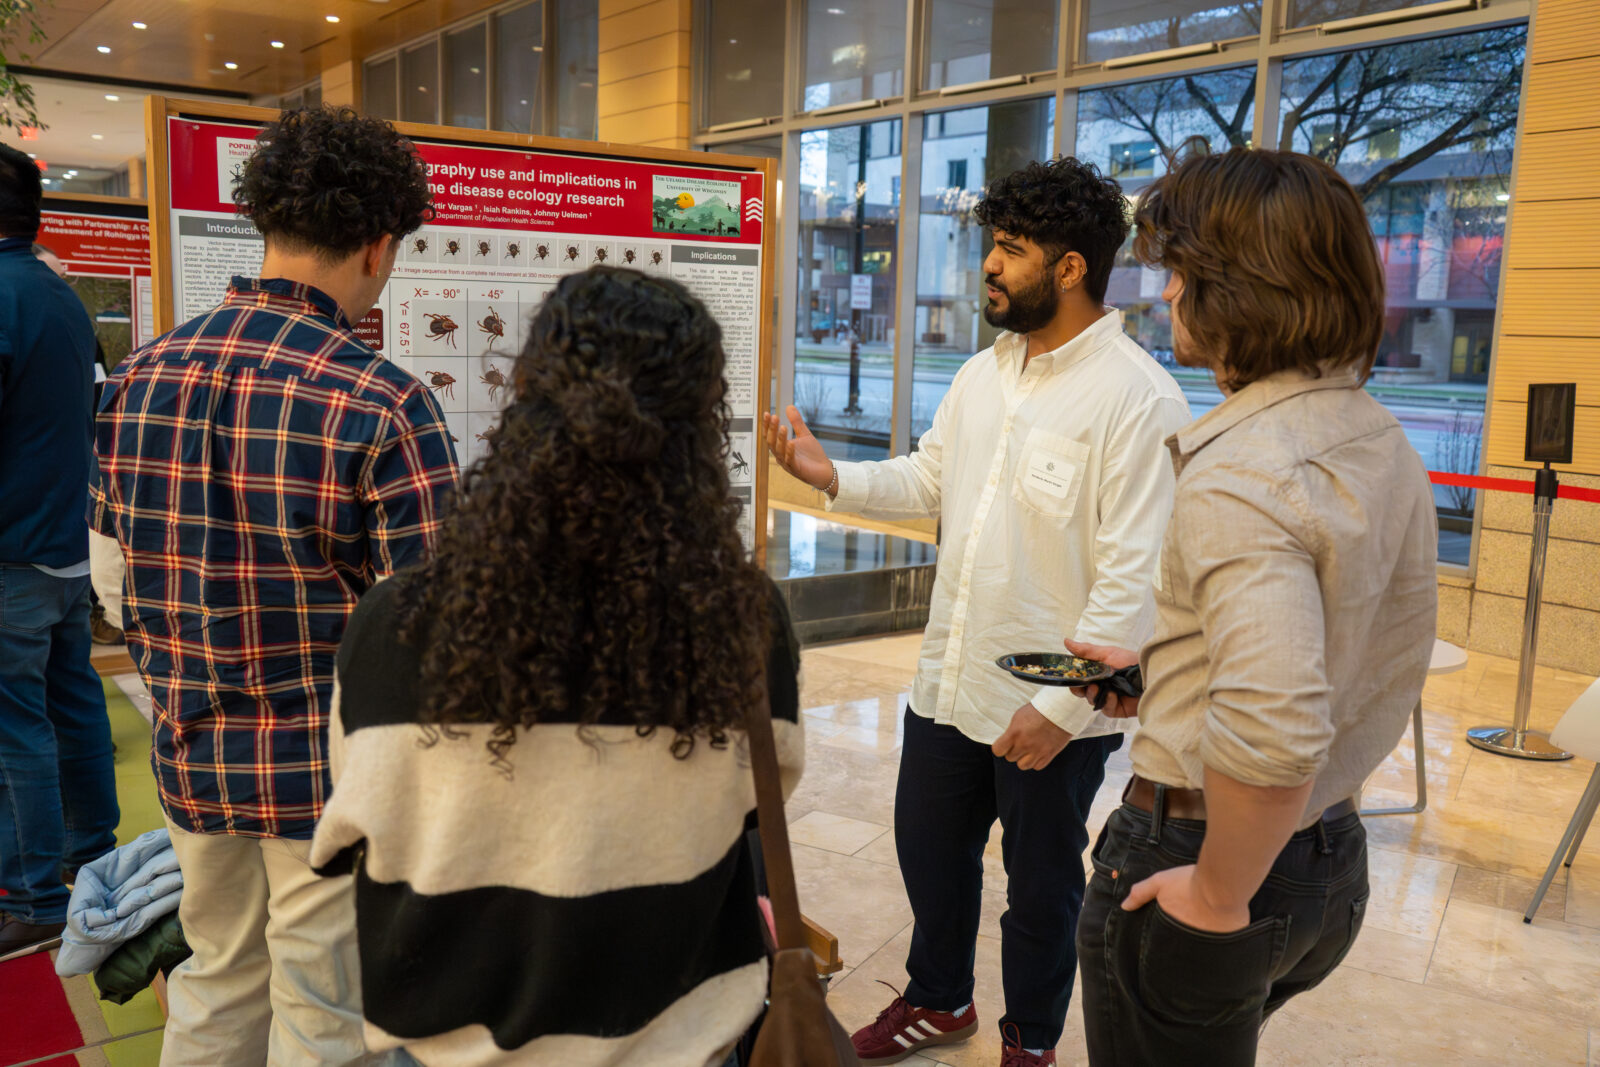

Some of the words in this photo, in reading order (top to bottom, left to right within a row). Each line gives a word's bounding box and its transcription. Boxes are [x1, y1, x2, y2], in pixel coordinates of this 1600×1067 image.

[426, 163, 475, 180] graphy
[480, 168, 505, 179] use
[509, 169, 534, 181] and
[540, 170, 621, 188] implications
[625, 177, 636, 190] in
[450, 182, 504, 198] disease
[508, 188, 562, 205] ecology
[567, 193, 624, 207] research
[436, 212, 473, 220] Department
[448, 203, 472, 212] Vargas
[502, 206, 532, 216] Rankins,
[534, 209, 559, 218] Johnny
[562, 211, 587, 219] Uelmen
[44, 226, 93, 236] Assessment
[104, 230, 140, 240] Rohingya
[691, 251, 737, 261] Implications
